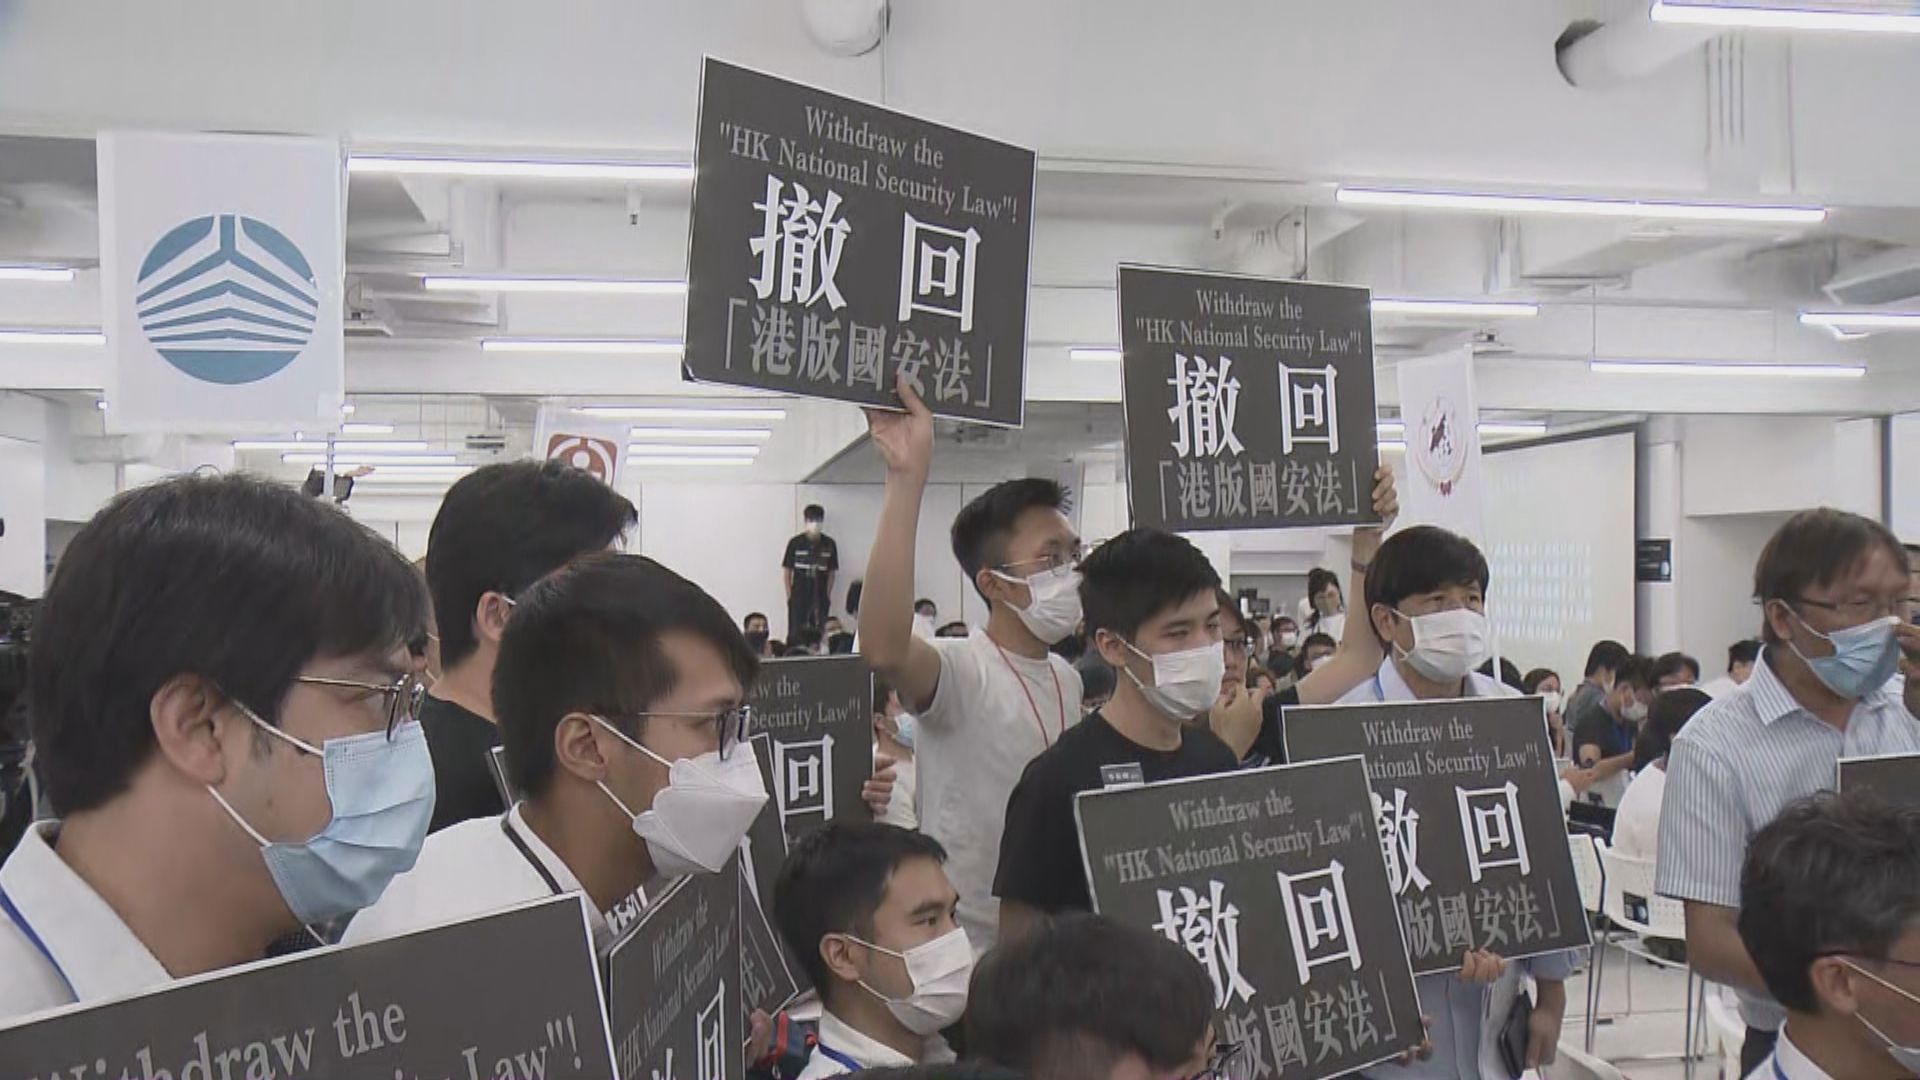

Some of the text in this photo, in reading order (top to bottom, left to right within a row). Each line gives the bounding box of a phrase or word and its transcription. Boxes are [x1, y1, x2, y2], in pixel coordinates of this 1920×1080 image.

[805, 106, 944, 169] Withdraw the
[720, 121, 1018, 223] "HK National Security Law"!
[1196, 289, 1303, 320] Withdraw the
[1136, 318, 1362, 357] "HK National Security Law"!
[776, 675, 800, 697] the
[750, 696, 861, 732] Security Law"!
[1362, 716, 1474, 747] Withdraw the
[1368, 742, 1541, 780] ational Security Law"!
[1168, 788, 1295, 832] Withdraw the
[1104, 811, 1368, 884] "HK National Security Law"!
[1401, 878, 1561, 960] 版國安法」
[332, 991, 407, 1058] the
[1222, 969, 1397, 1080] 版國安法」
